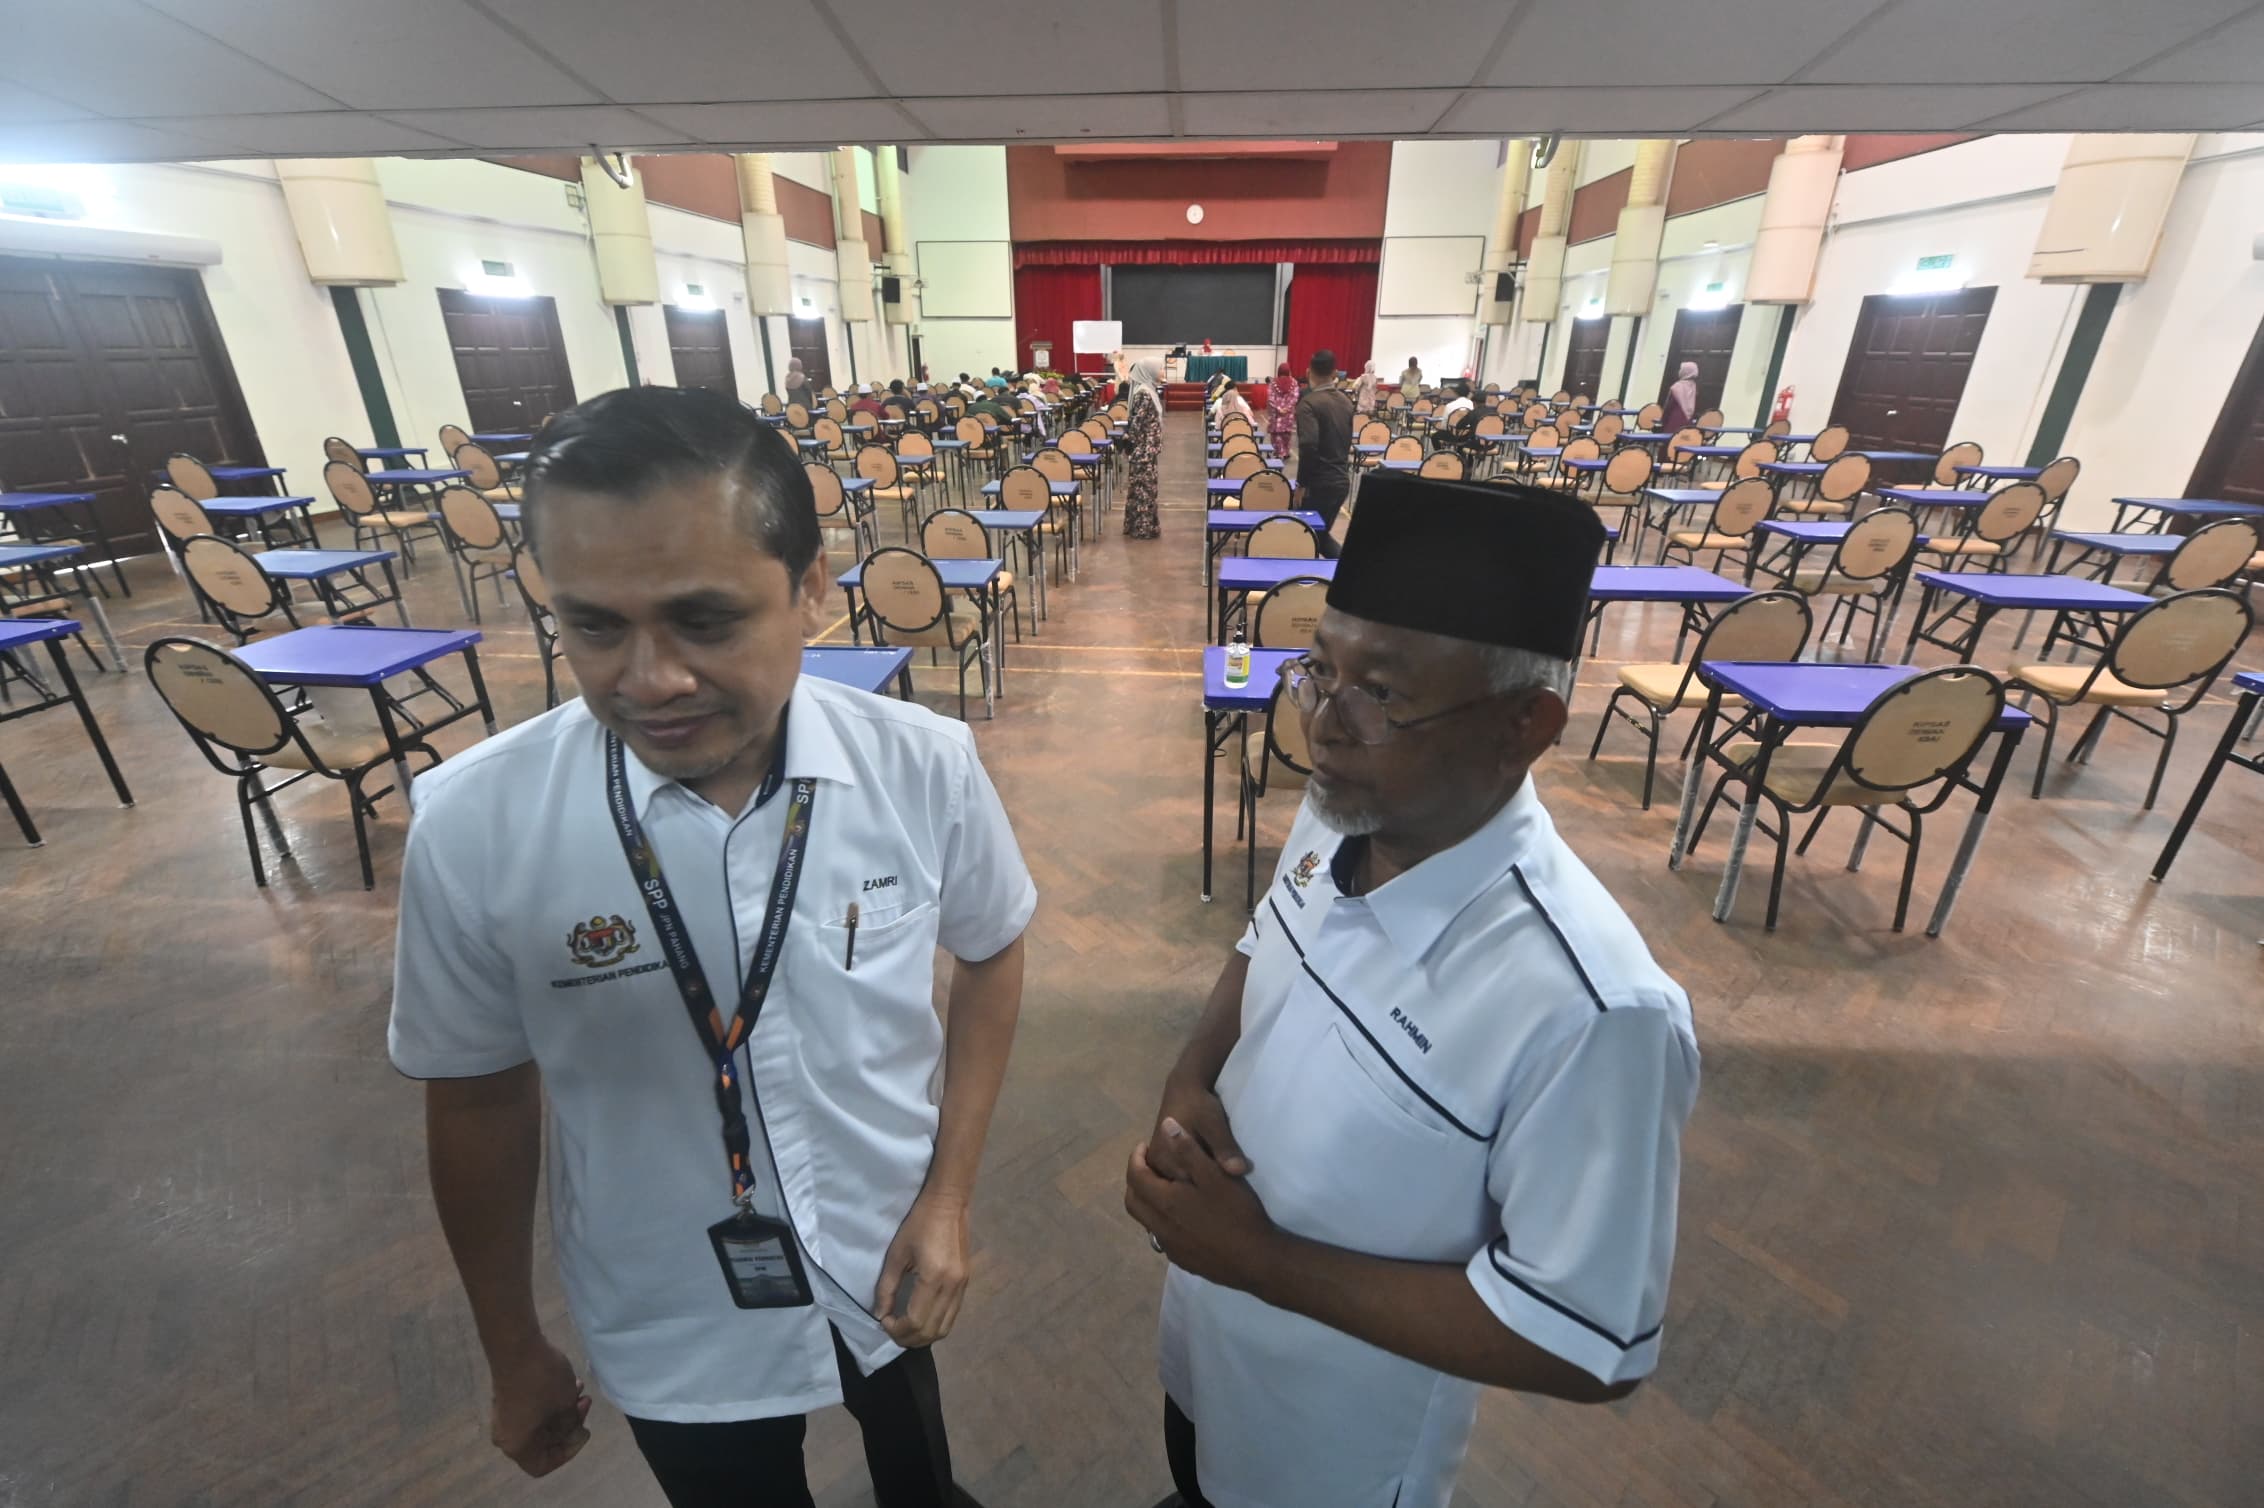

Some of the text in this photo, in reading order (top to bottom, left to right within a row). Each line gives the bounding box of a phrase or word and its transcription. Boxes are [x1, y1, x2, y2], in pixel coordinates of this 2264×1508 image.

[612, 779, 633, 837] PENDIDIKAN
[644, 879, 668, 909] SPP
[863, 875, 898, 891] ZAMRI
[659, 914, 673, 931] JPN
[759, 848, 798, 973] KEMENTERIAN PENDIDIKAN
[1390, 1006, 1432, 1054] RAHMIN
